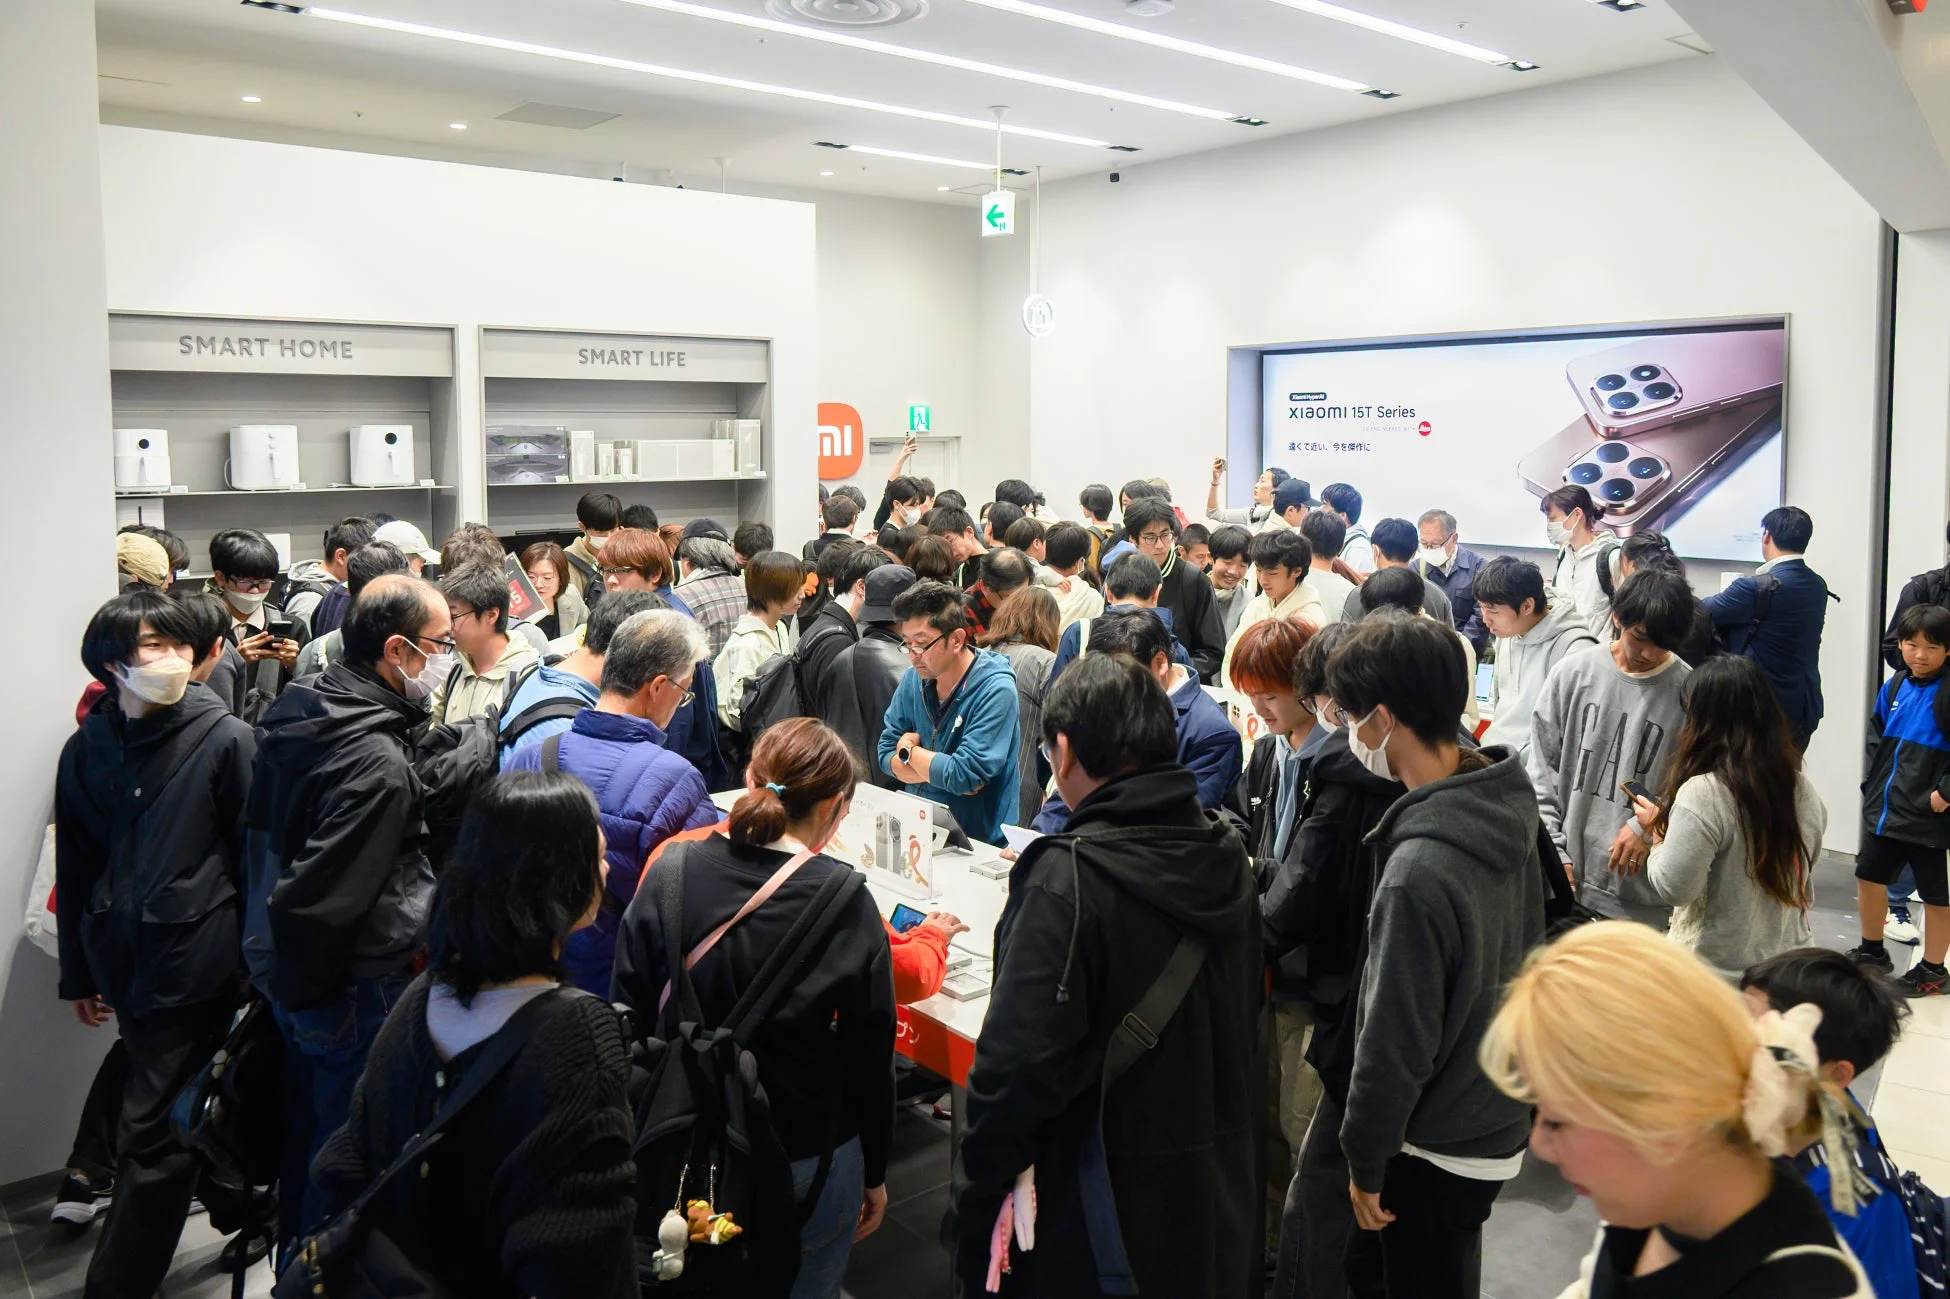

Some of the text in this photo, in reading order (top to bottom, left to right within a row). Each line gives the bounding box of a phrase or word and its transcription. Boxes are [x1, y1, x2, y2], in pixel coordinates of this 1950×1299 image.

[179, 335, 354, 359] SMART HOME
[578, 348, 686, 367] SMART LIFE
[1351, 406, 1372, 418] 15T
[1377, 405, 1416, 418] Series
[1573, 702, 1665, 810] GAP
